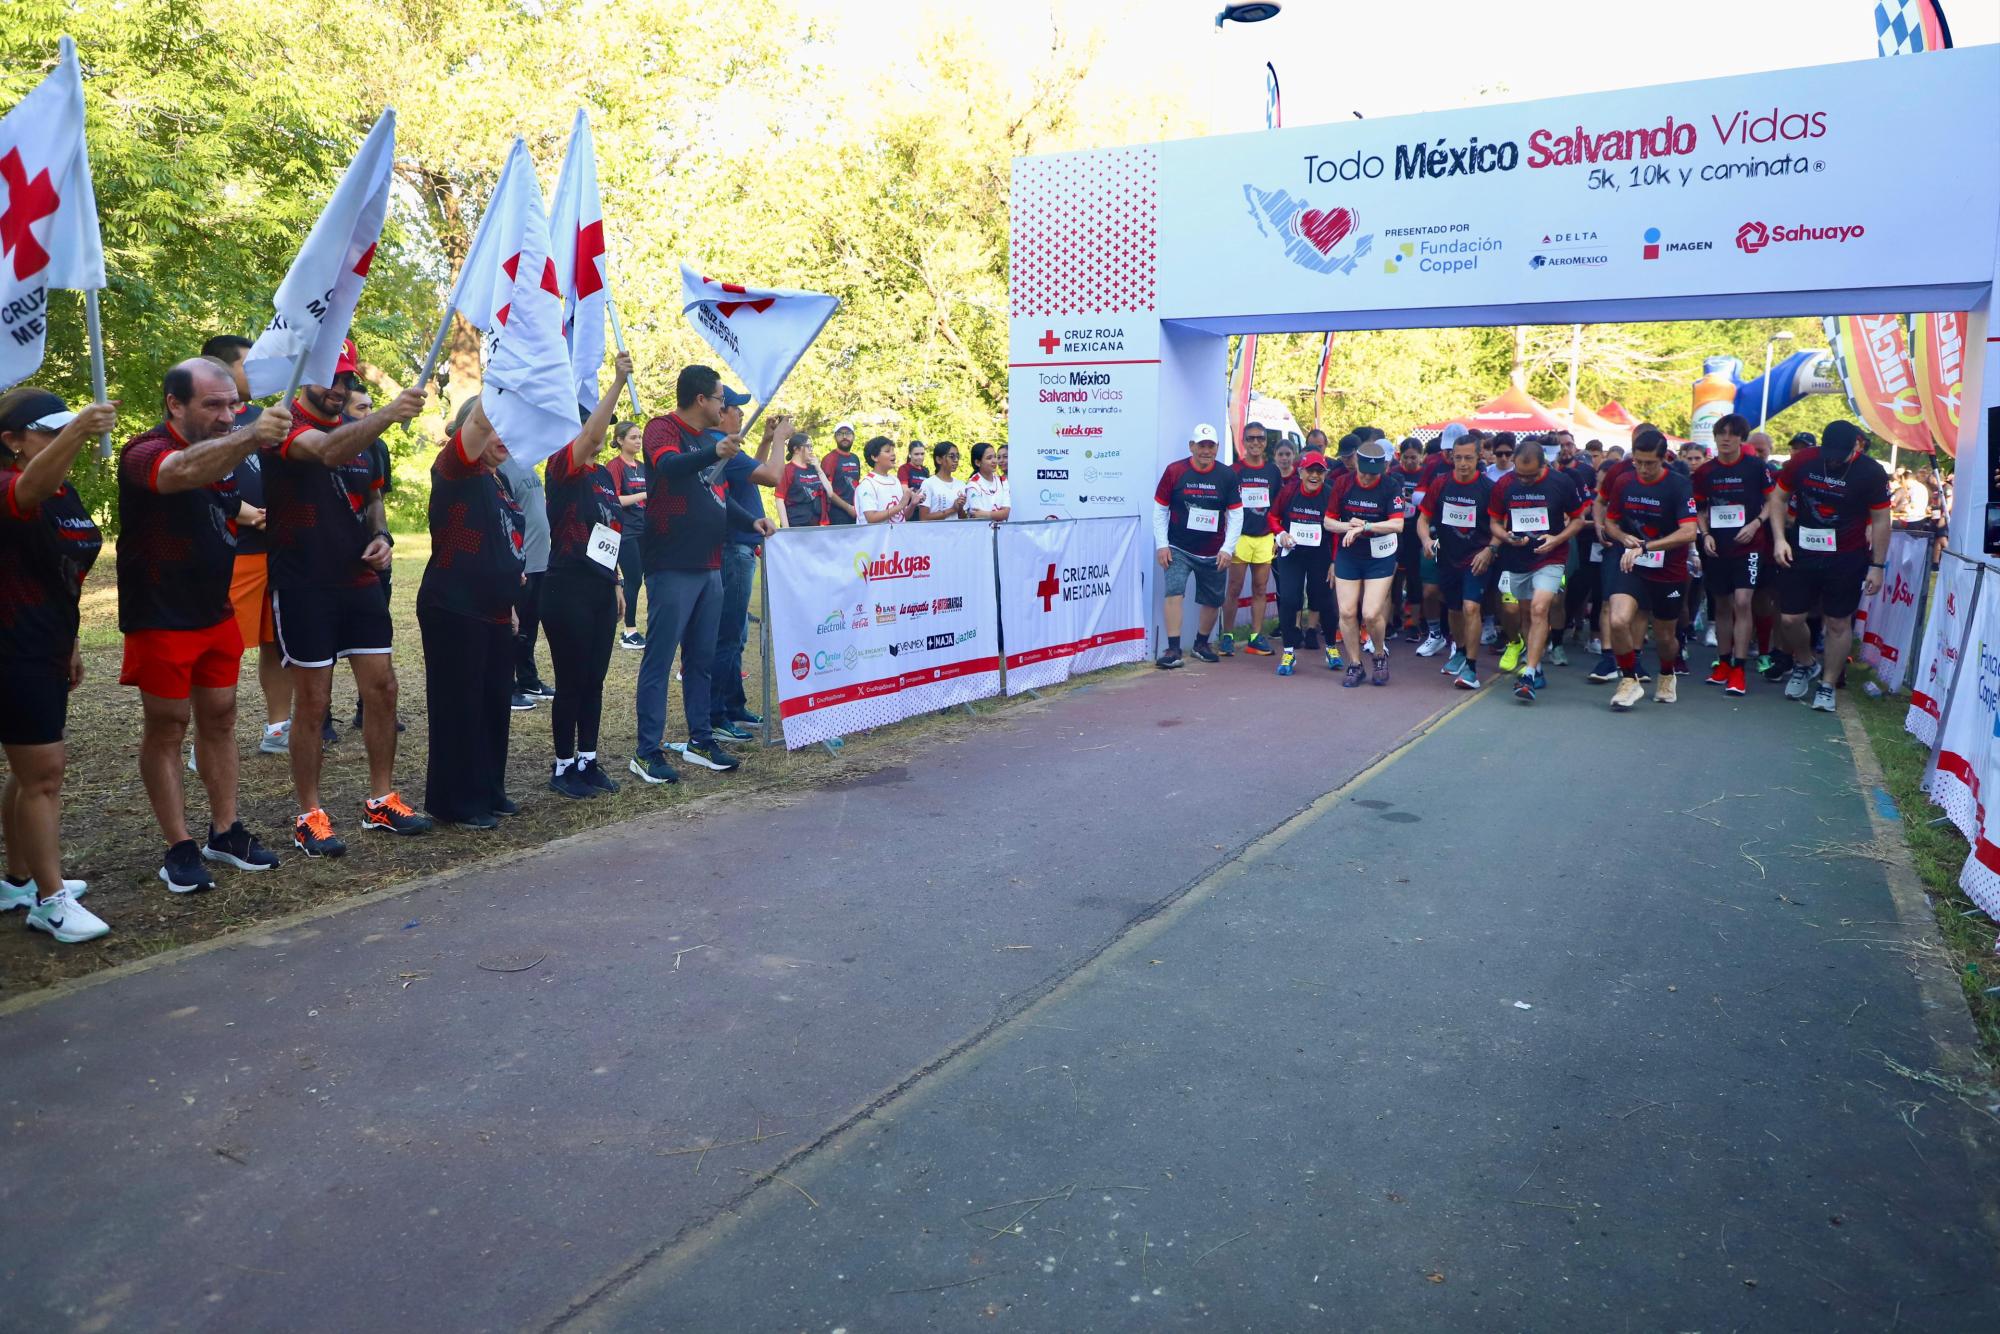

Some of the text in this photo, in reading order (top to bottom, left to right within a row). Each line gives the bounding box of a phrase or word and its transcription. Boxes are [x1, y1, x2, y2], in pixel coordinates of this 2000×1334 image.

[1304, 108, 1828, 184] Todo México Salvando Vidas
[1587, 168, 1620, 192] 5k,
[1628, 164, 1671, 188] 10k
[1679, 168, 1693, 187] y
[1700, 153, 1809, 181] caminata
[1385, 223, 1470, 237] PRESENTADO POR
[1555, 232, 1598, 242] DELTA
[1771, 224, 1865, 242] Sahuayo
[1420, 238, 1503, 255] Fundación
[1665, 241, 1713, 251] IMAGEN
[1420, 256, 1478, 274] Coppel
[699, 303, 739, 346] CRUZ ROJA
[697, 312, 740, 357] MEXICANA
[1064, 328, 1124, 339] CRUZ ROJA
[1064, 341, 1124, 352] MEXICANA
[1039, 371, 1110, 386] Todo México
[1039, 388, 1123, 403] Salvando Vidas
[1046, 470, 1068, 479] MAJA
[1090, 495, 1125, 503] EVENMEX
[1449, 512, 1468, 520] 0057
[1296, 531, 1314, 539] 0015
[598, 540, 618, 556] 0933
[1088, 564, 1110, 580] ROJA
